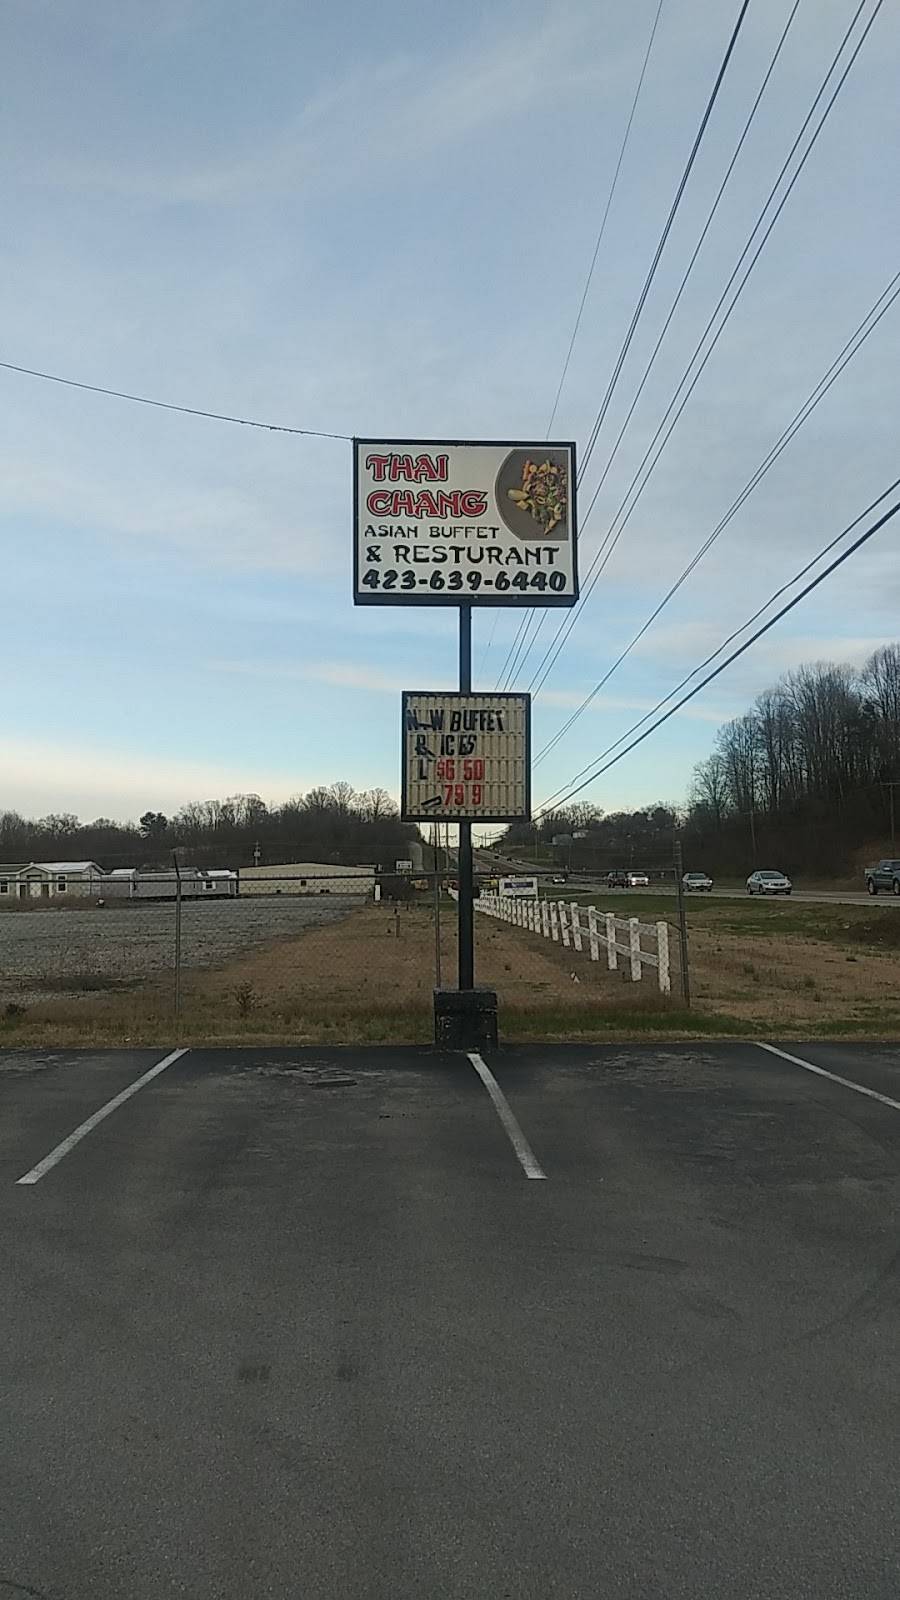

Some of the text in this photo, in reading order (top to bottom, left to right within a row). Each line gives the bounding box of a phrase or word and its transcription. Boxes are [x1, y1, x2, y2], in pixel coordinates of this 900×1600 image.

[365, 453, 449, 483] THAI
[366, 490, 488, 519] CHANG
[364, 525, 500, 539] ASIAN BUFFET
[366, 545, 559, 565] & RESTURANT
[362, 569, 567, 592] 423-639-6440
[450, 709, 504, 732] BUFFET
